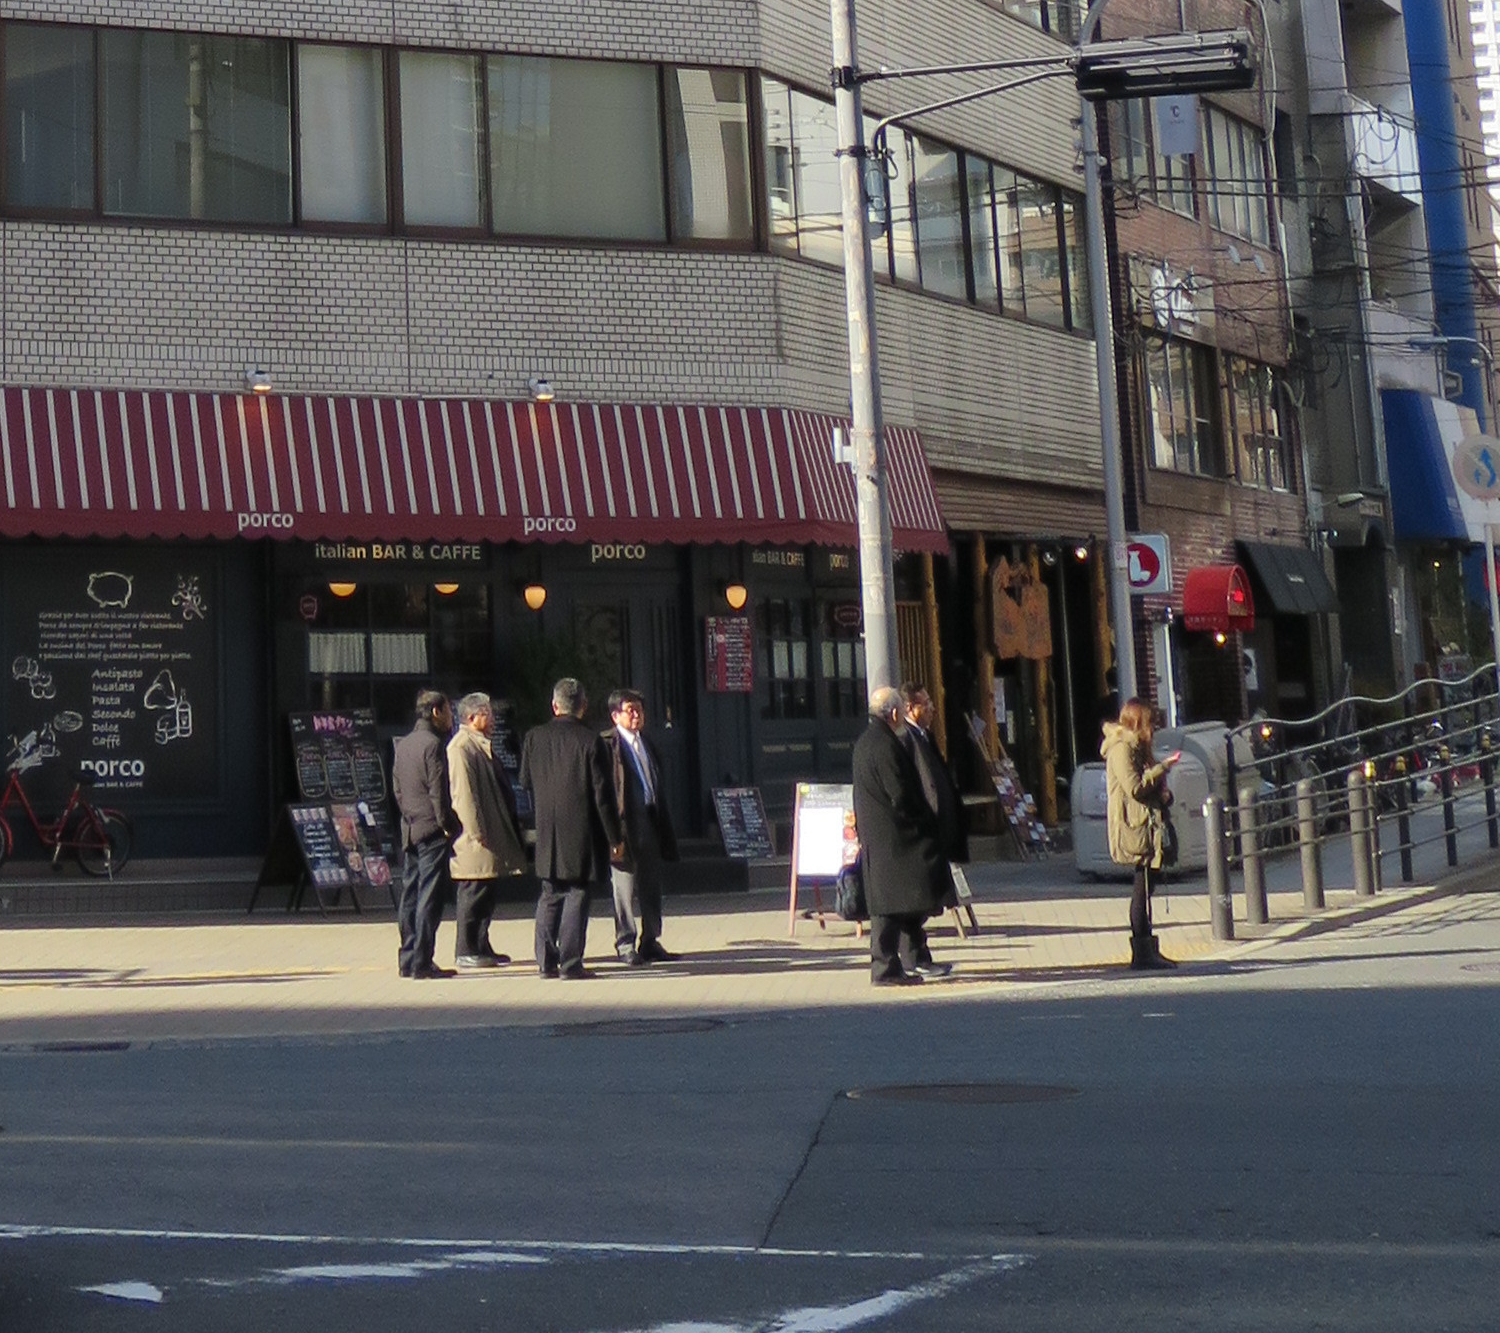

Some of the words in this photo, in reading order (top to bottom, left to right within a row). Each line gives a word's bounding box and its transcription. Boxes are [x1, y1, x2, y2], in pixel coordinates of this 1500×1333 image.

[238, 513, 294, 531] porco
[524, 517, 577, 535] porco
[315, 543, 367, 559] italian
[372, 544, 407, 559] BAR
[412, 544, 424, 560] &
[430, 545, 481, 560] CAFFE
[591, 544, 646, 563] porco
[91, 666, 144, 681] Antipasto
[92, 683, 135, 692] Insalata
[91, 695, 120, 705] Pasta
[92, 708, 136, 719] Secondo
[92, 722, 119, 732] Dolce
